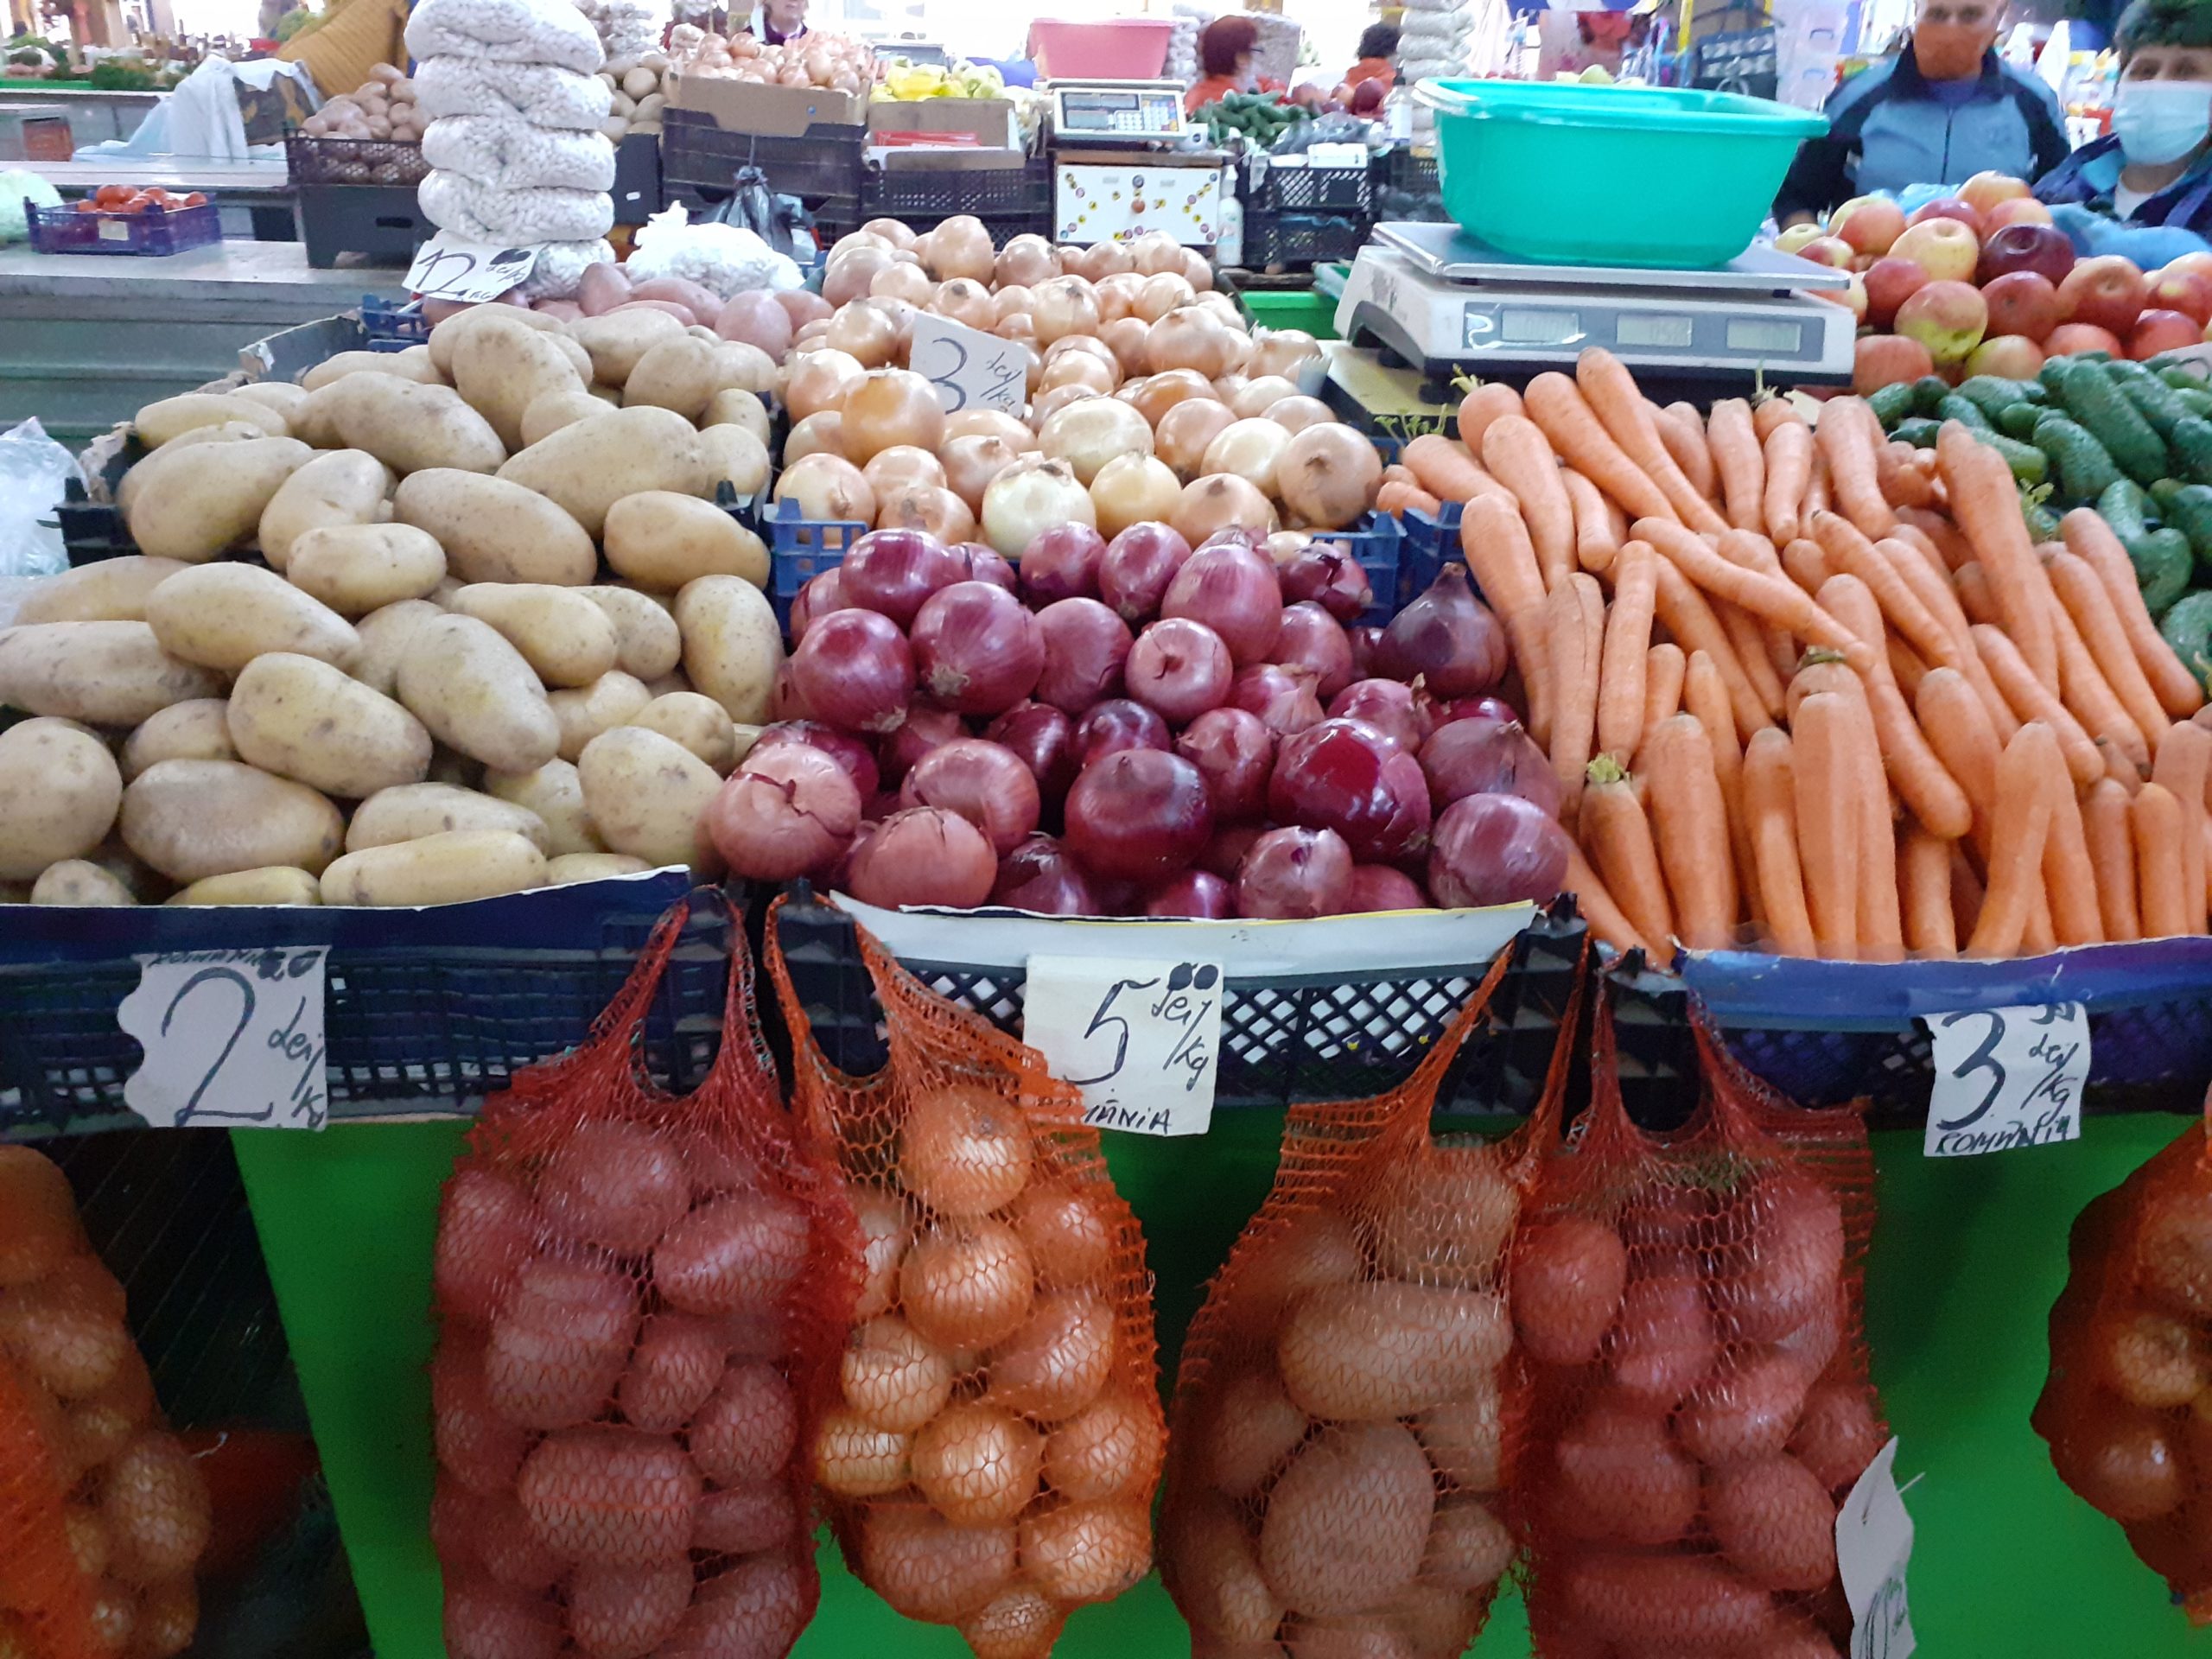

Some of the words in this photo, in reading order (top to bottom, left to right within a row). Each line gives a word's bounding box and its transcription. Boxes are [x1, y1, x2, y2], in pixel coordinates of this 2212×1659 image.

[929, 337, 968, 415] 3
[162, 966, 273, 1127] 2
[1063, 978, 1160, 1085] 5
[1936, 1011, 2005, 1131] 3
